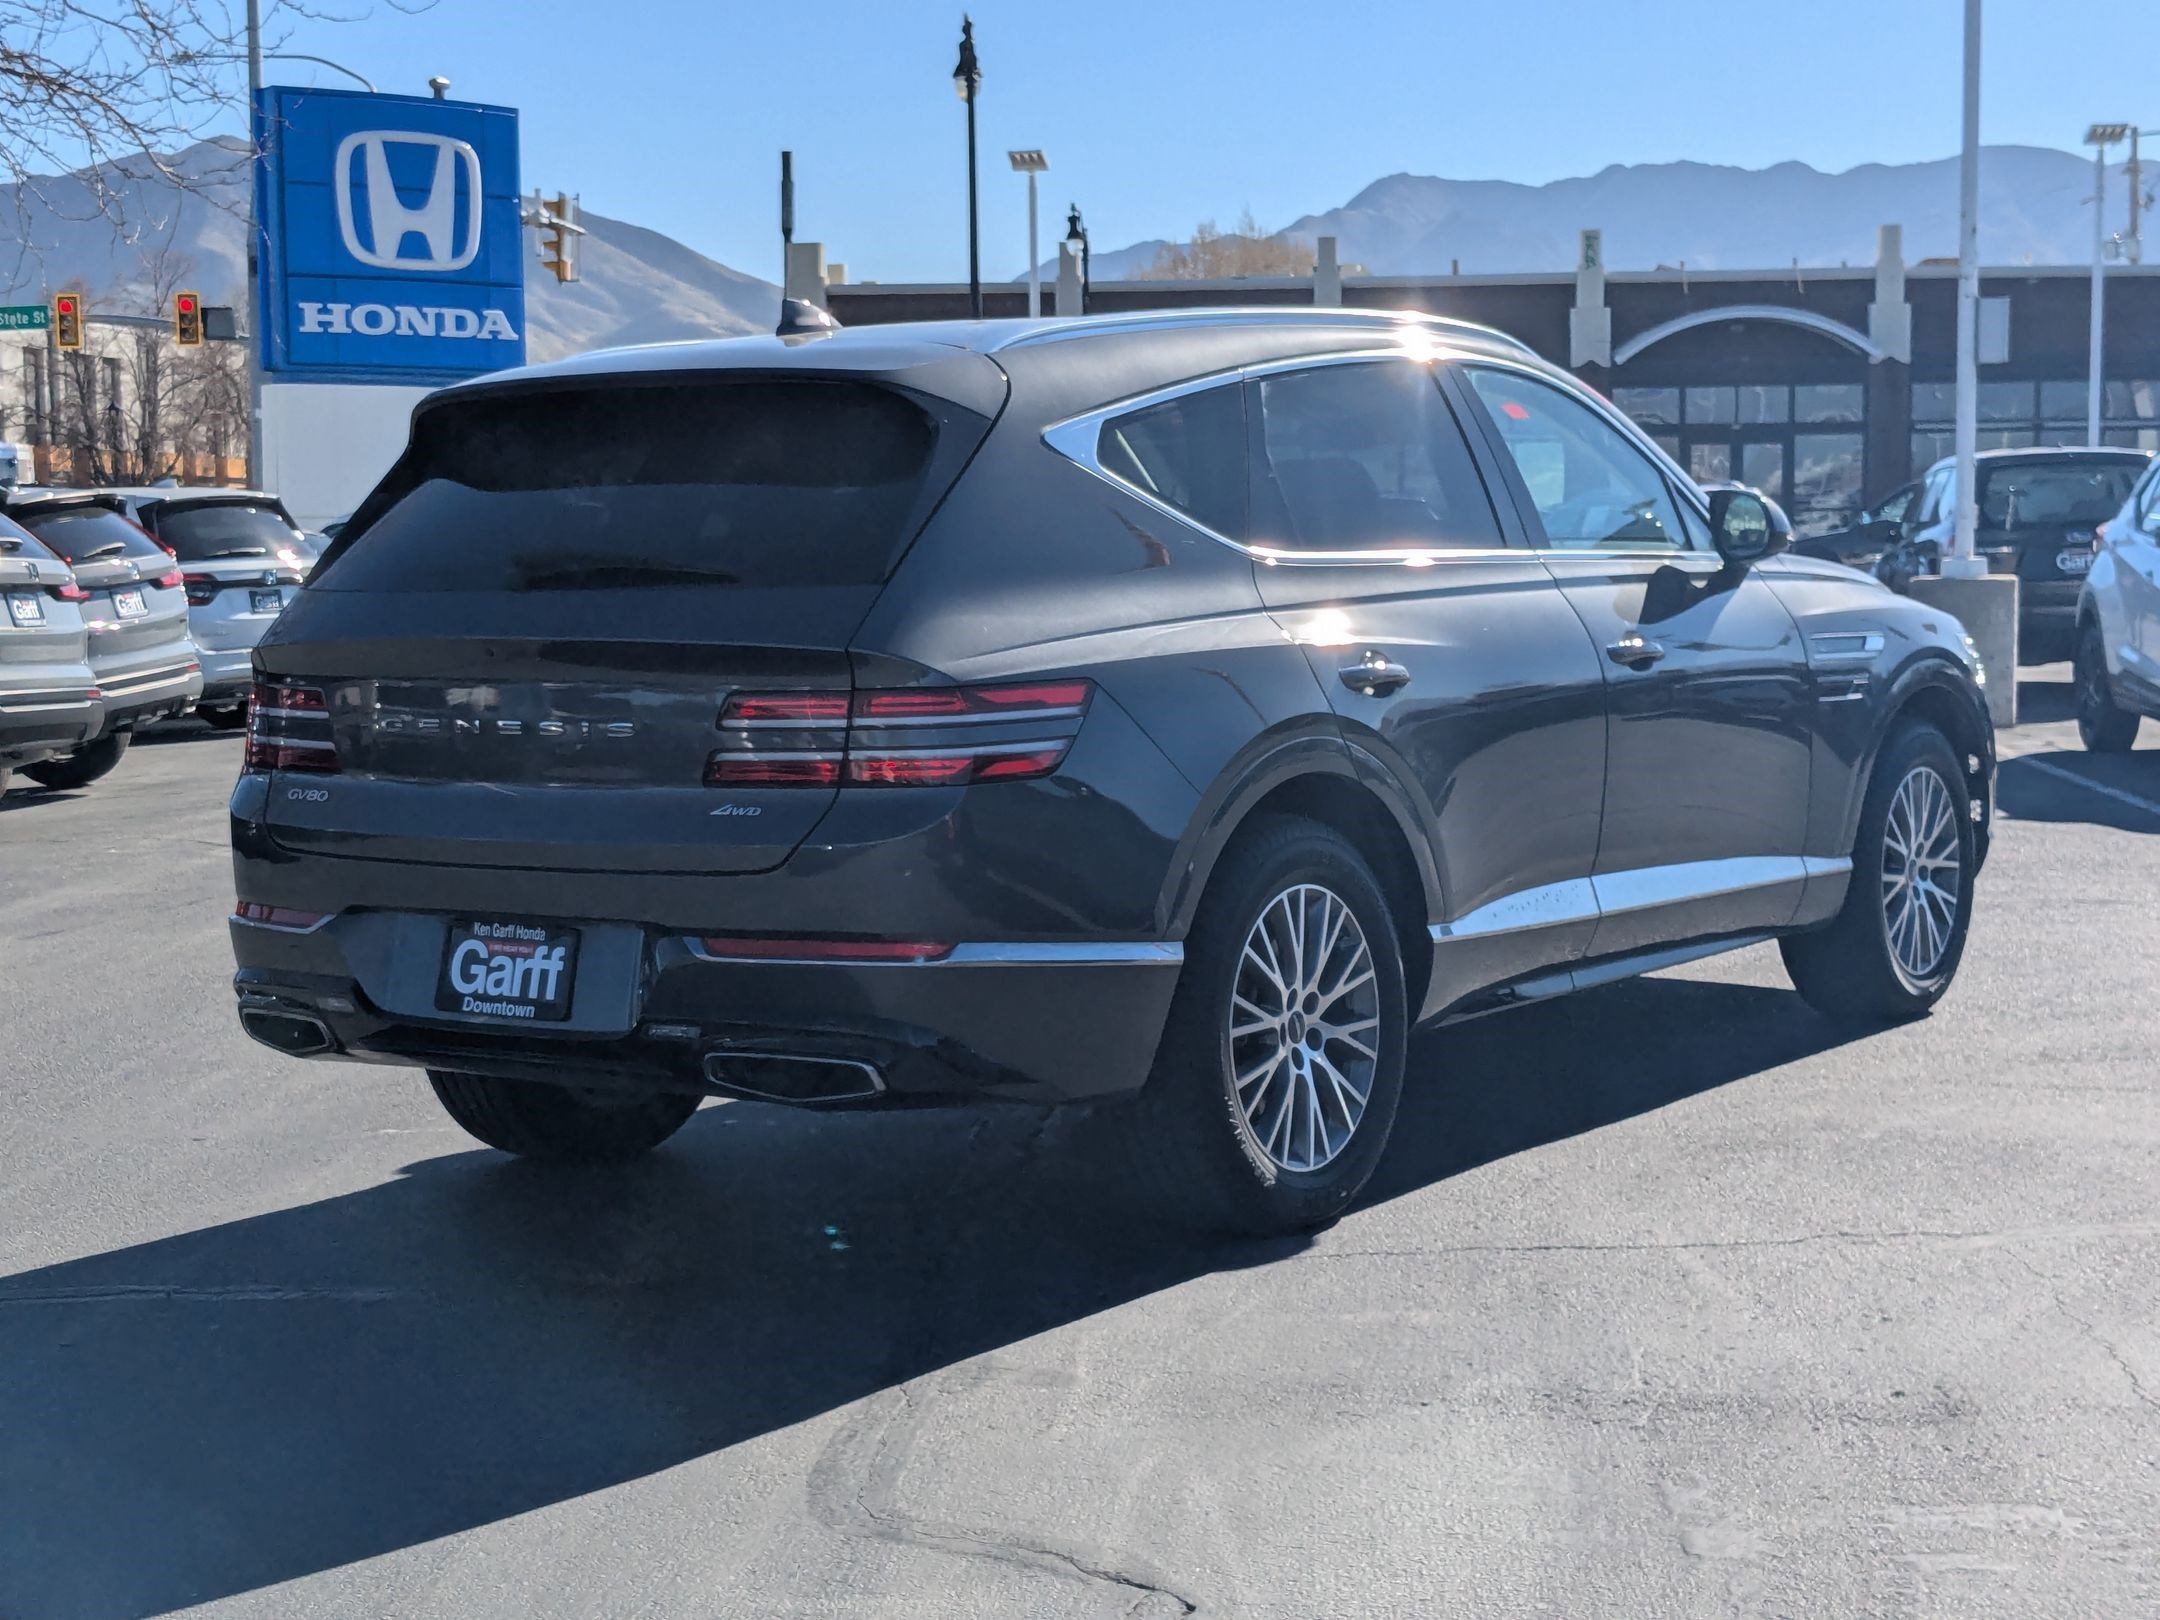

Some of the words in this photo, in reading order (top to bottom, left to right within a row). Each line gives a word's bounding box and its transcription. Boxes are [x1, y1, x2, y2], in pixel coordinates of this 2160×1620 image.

[33, 310, 46, 324] St
[298, 302, 519, 341] HONDA
[2055, 551, 2094, 570] Garf
[380, 717, 635, 738] GENESIS
[287, 788, 329, 801] GV80
[473, 921, 491, 938] Ken
[492, 922, 516, 938] Garff
[516, 924, 546, 942] Honda
[450, 938, 566, 1001] Garff
[462, 995, 536, 1019] Downtown
